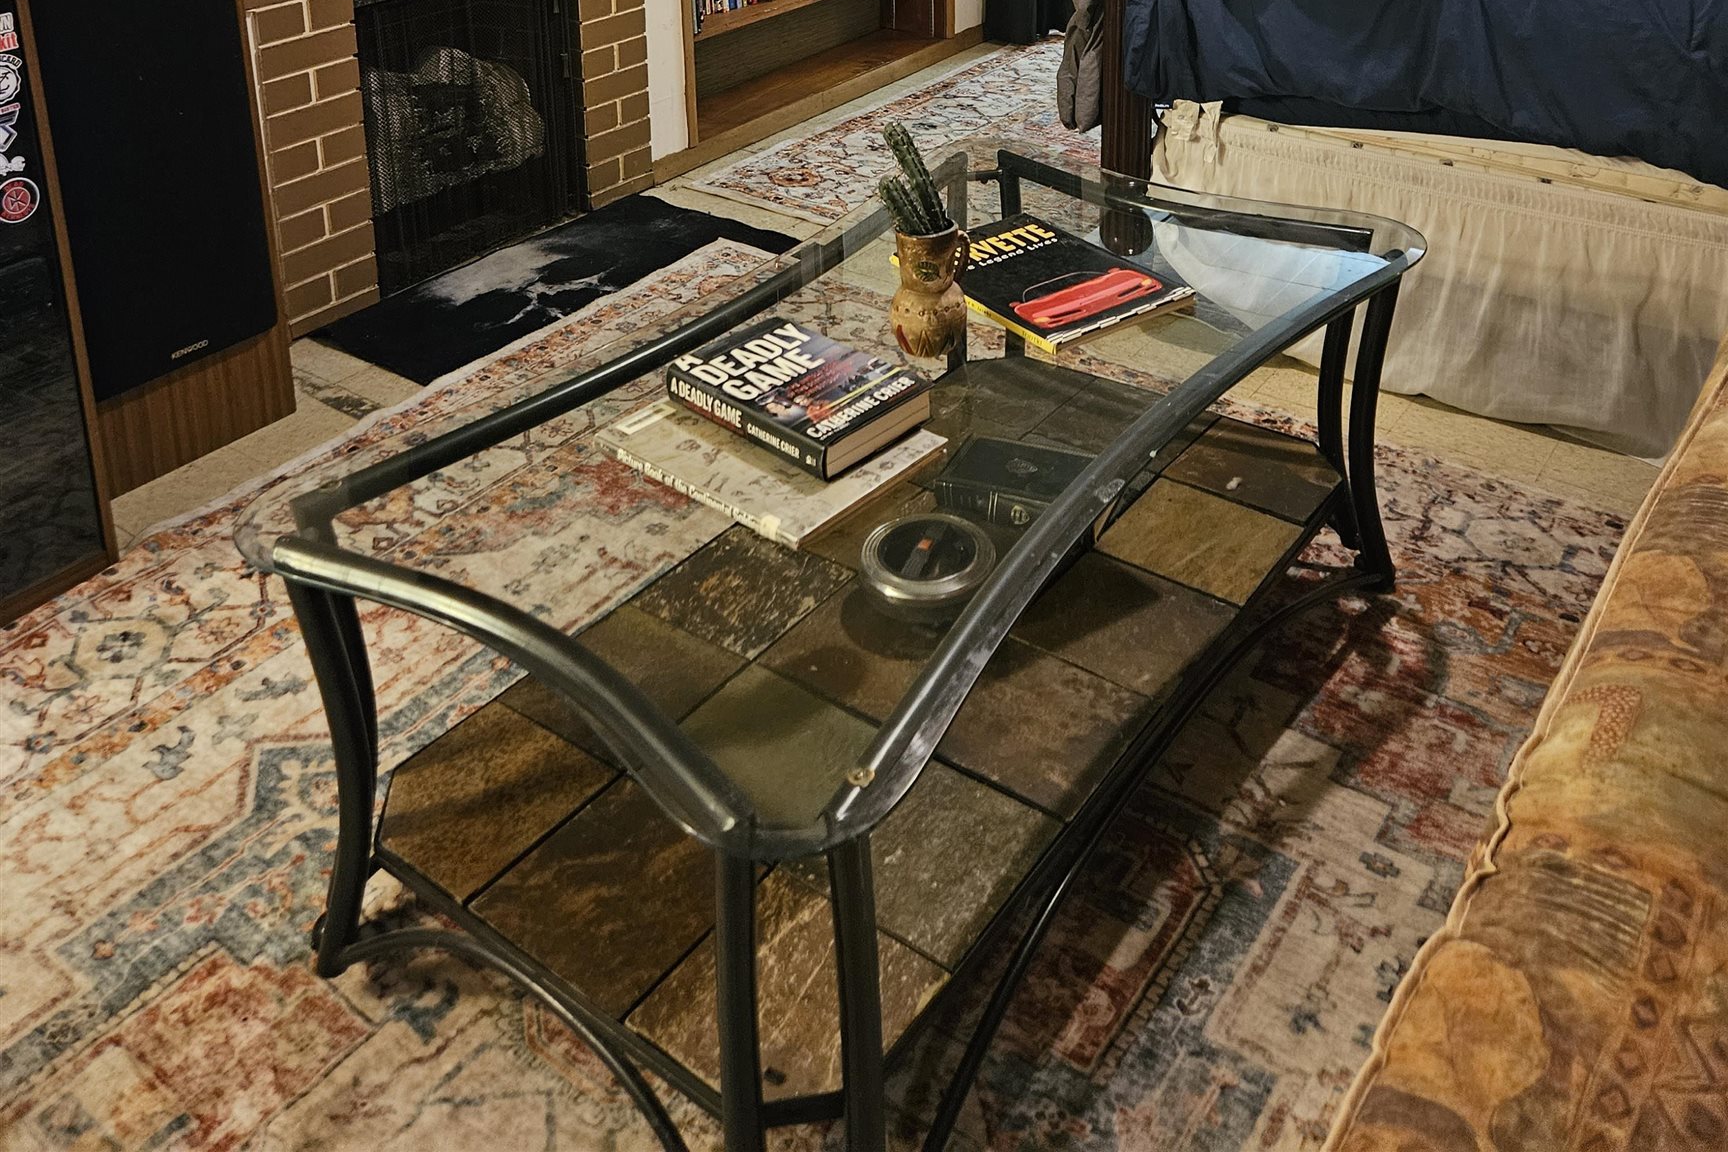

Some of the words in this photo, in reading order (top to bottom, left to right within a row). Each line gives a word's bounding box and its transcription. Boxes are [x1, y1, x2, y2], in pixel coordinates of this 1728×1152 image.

[958, 224, 1056, 262] RVETTE
[171, 339, 209, 360] KENWOOD
[674, 354, 704, 372] A
[689, 323, 812, 387] DEADLY
[722, 347, 826, 401] GAME
[670, 376, 679, 394] A
[678, 380, 714, 413] DEADLY
[713, 399, 743, 428] GAME
[806, 396, 881, 439] CATHERINE
[873, 376, 916, 401] CRIER
[746, 423, 781, 449] CATHERINE
[780, 440, 800, 460] CRIER
